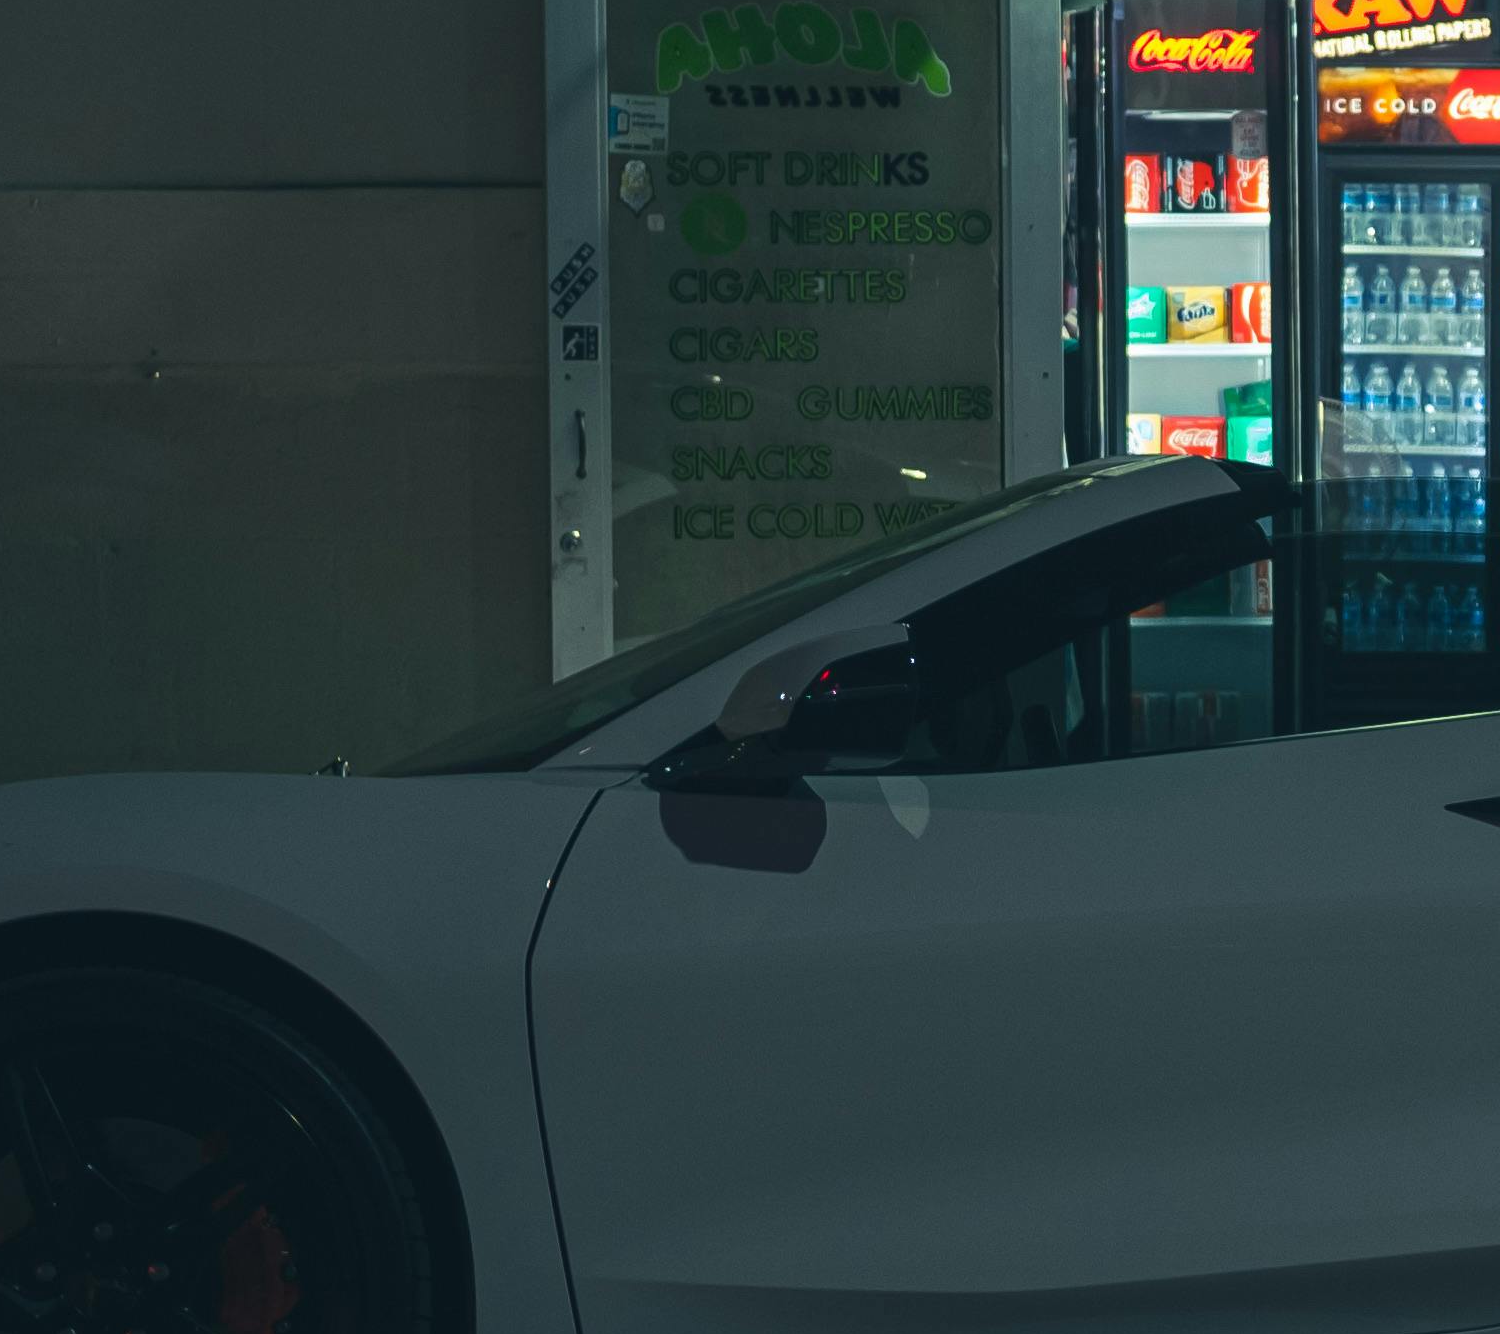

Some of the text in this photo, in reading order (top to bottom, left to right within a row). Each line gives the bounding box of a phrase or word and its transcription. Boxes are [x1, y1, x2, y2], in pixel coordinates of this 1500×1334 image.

[1436, 17, 1492, 43] PAPERS
[1128, 28, 1260, 74] Coca-Cola
[1324, 97, 1362, 114] ICE
[1375, 96, 1437, 114] COLD
[666, 150, 930, 187] SOFT DRINKS
[770, 209, 992, 246] NESPRESSO
[552, 246, 592, 292] PUSH
[668, 267, 906, 305] CIGARETTES
[556, 271, 595, 315] PUSH
[669, 327, 819, 363] CIGARS
[670, 385, 994, 420] CBD GUMMIES
[671, 444, 833, 481] SNACKS
[673, 503, 735, 540] ICE
[747, 503, 865, 539] COLD
